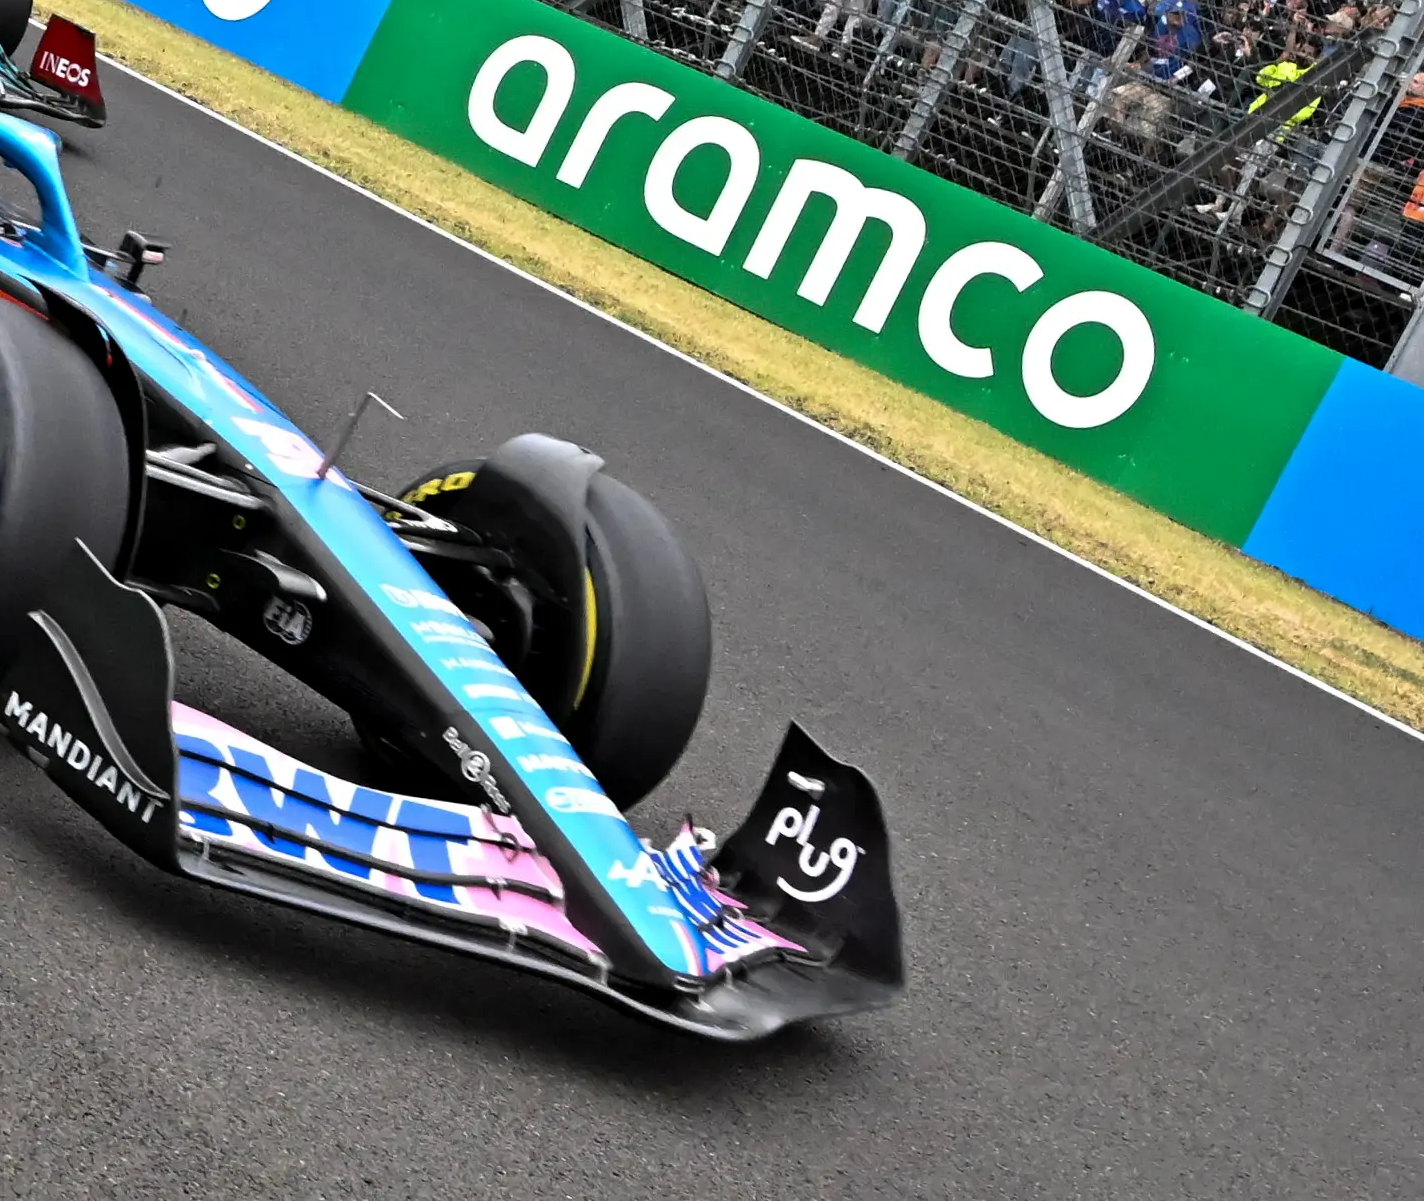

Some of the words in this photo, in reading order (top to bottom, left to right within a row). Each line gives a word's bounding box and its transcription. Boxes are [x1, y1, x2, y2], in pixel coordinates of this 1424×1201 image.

[39, 50, 92, 88] INEOS
[466, 33, 1156, 430] aramco
[4, 690, 165, 825] MANDIANT
[764, 804, 859, 903] plug
